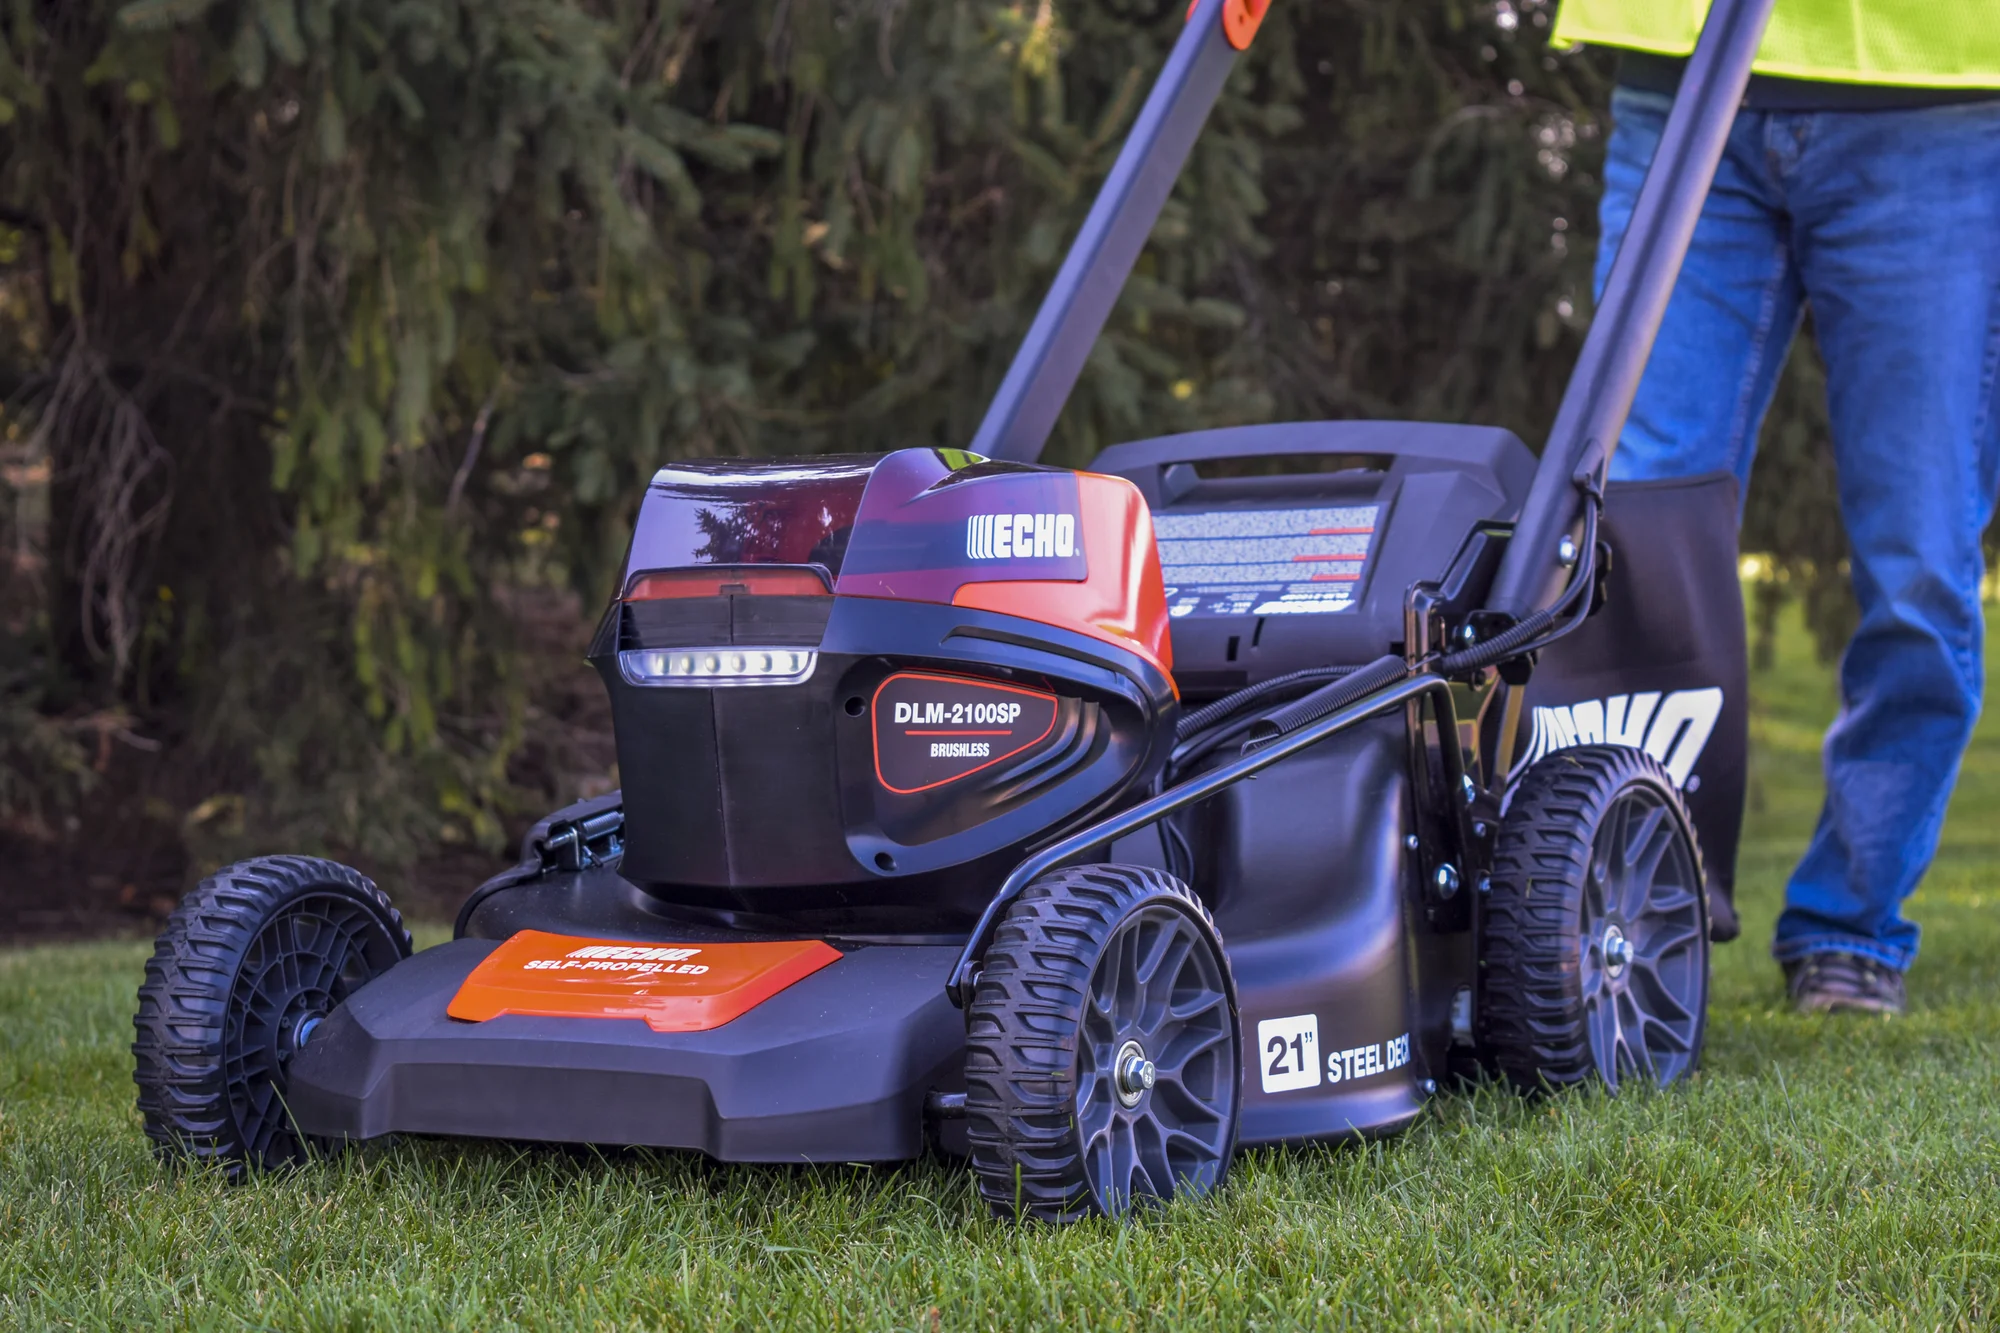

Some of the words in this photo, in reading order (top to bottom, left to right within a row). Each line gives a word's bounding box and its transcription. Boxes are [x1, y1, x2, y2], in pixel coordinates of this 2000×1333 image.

[967, 514, 1076, 559] ECHO
[894, 702, 1021, 724] DLM-2100SP
[930, 743, 990, 757] BRUSHLESS
[566, 946, 702, 961] ECHO
[523, 960, 709, 975] SELF-PROPELLED
[1327, 1044, 1385, 1083] STEEL
